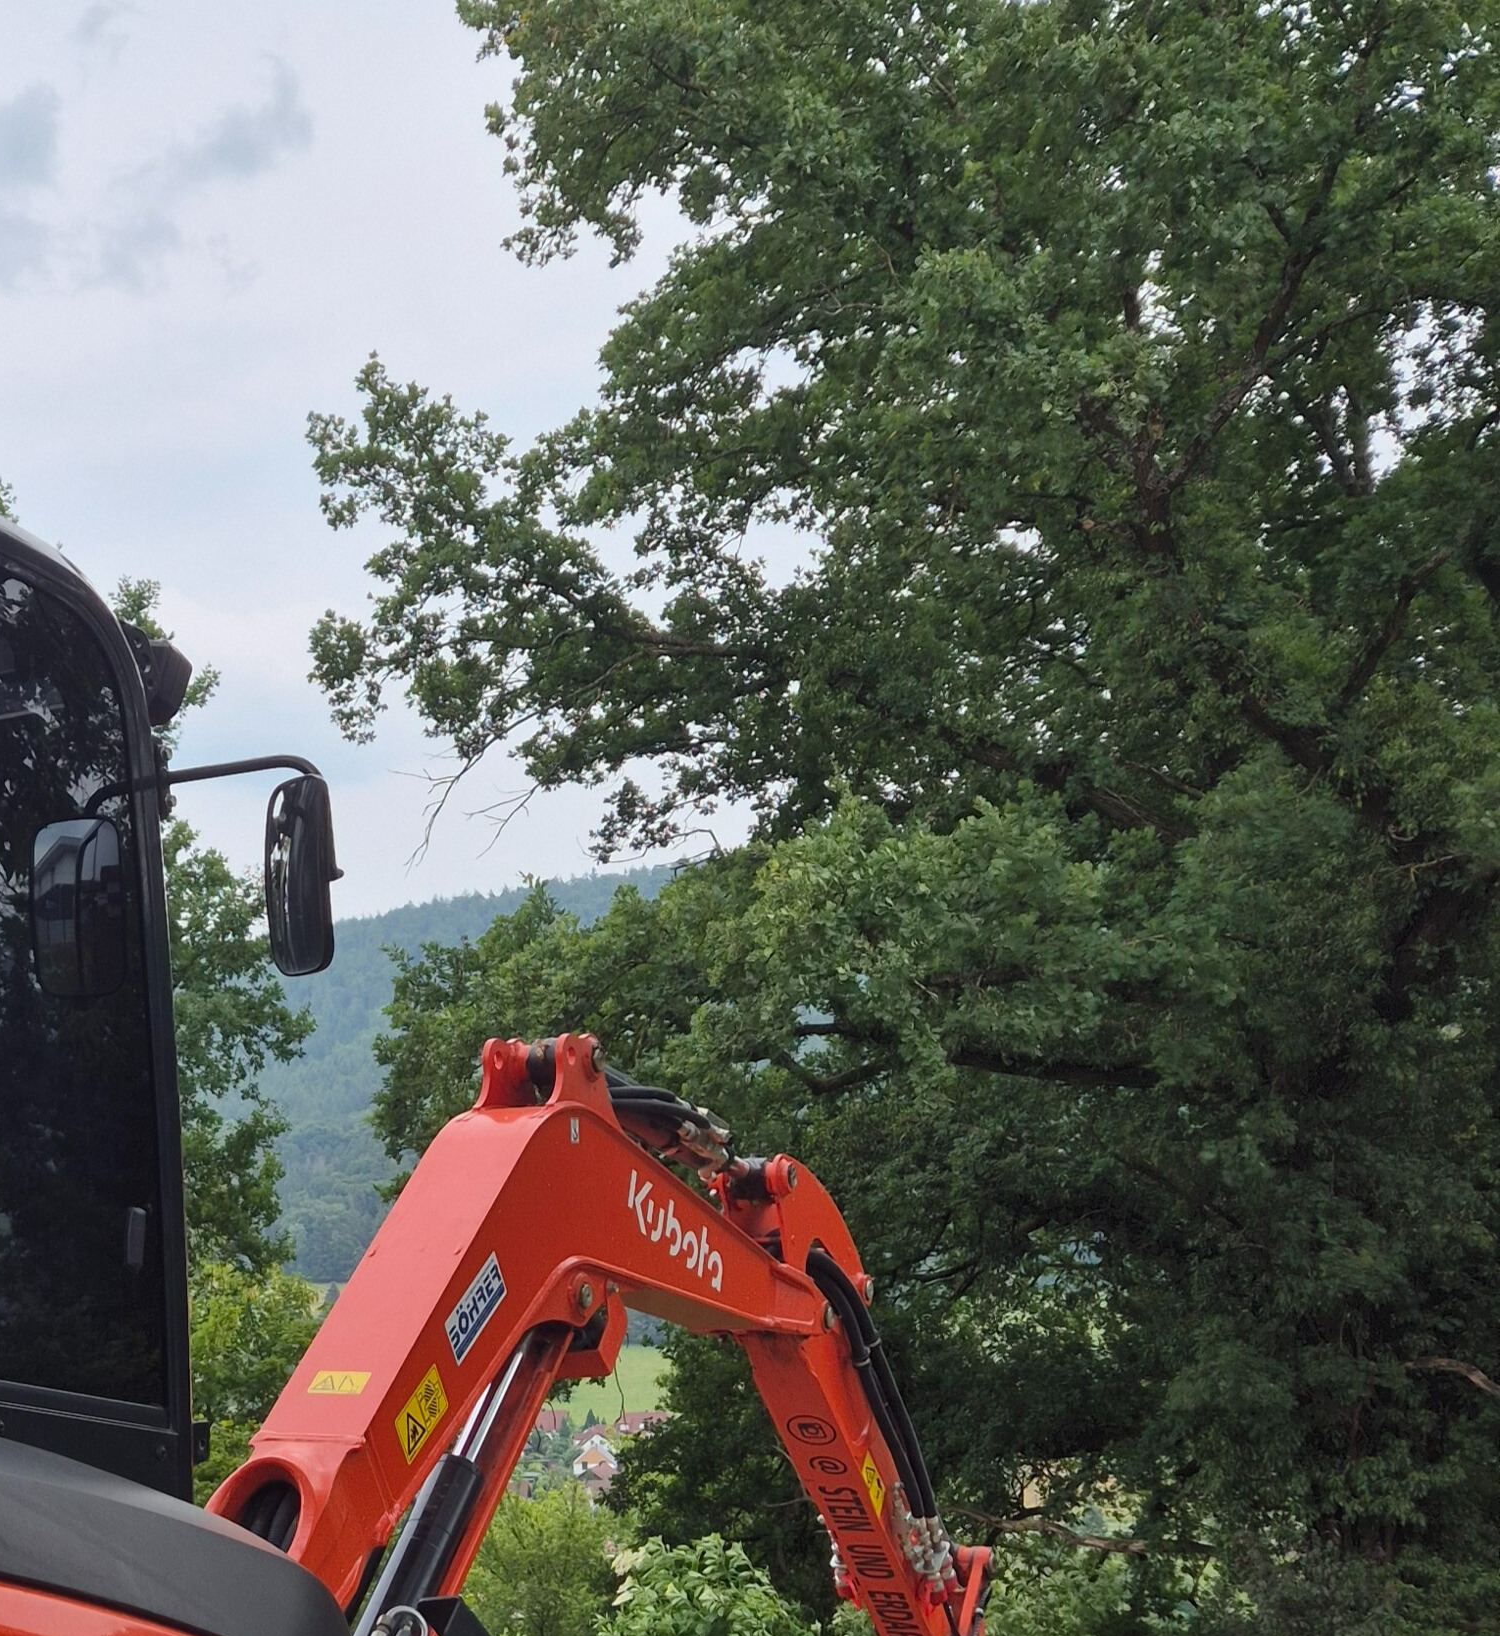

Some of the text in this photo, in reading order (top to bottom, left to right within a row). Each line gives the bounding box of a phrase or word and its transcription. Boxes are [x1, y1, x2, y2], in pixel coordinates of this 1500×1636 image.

[628, 1169, 723, 1293] Kubota
[819, 1486, 873, 1532] STEIN
[847, 1544, 894, 1580] UND
